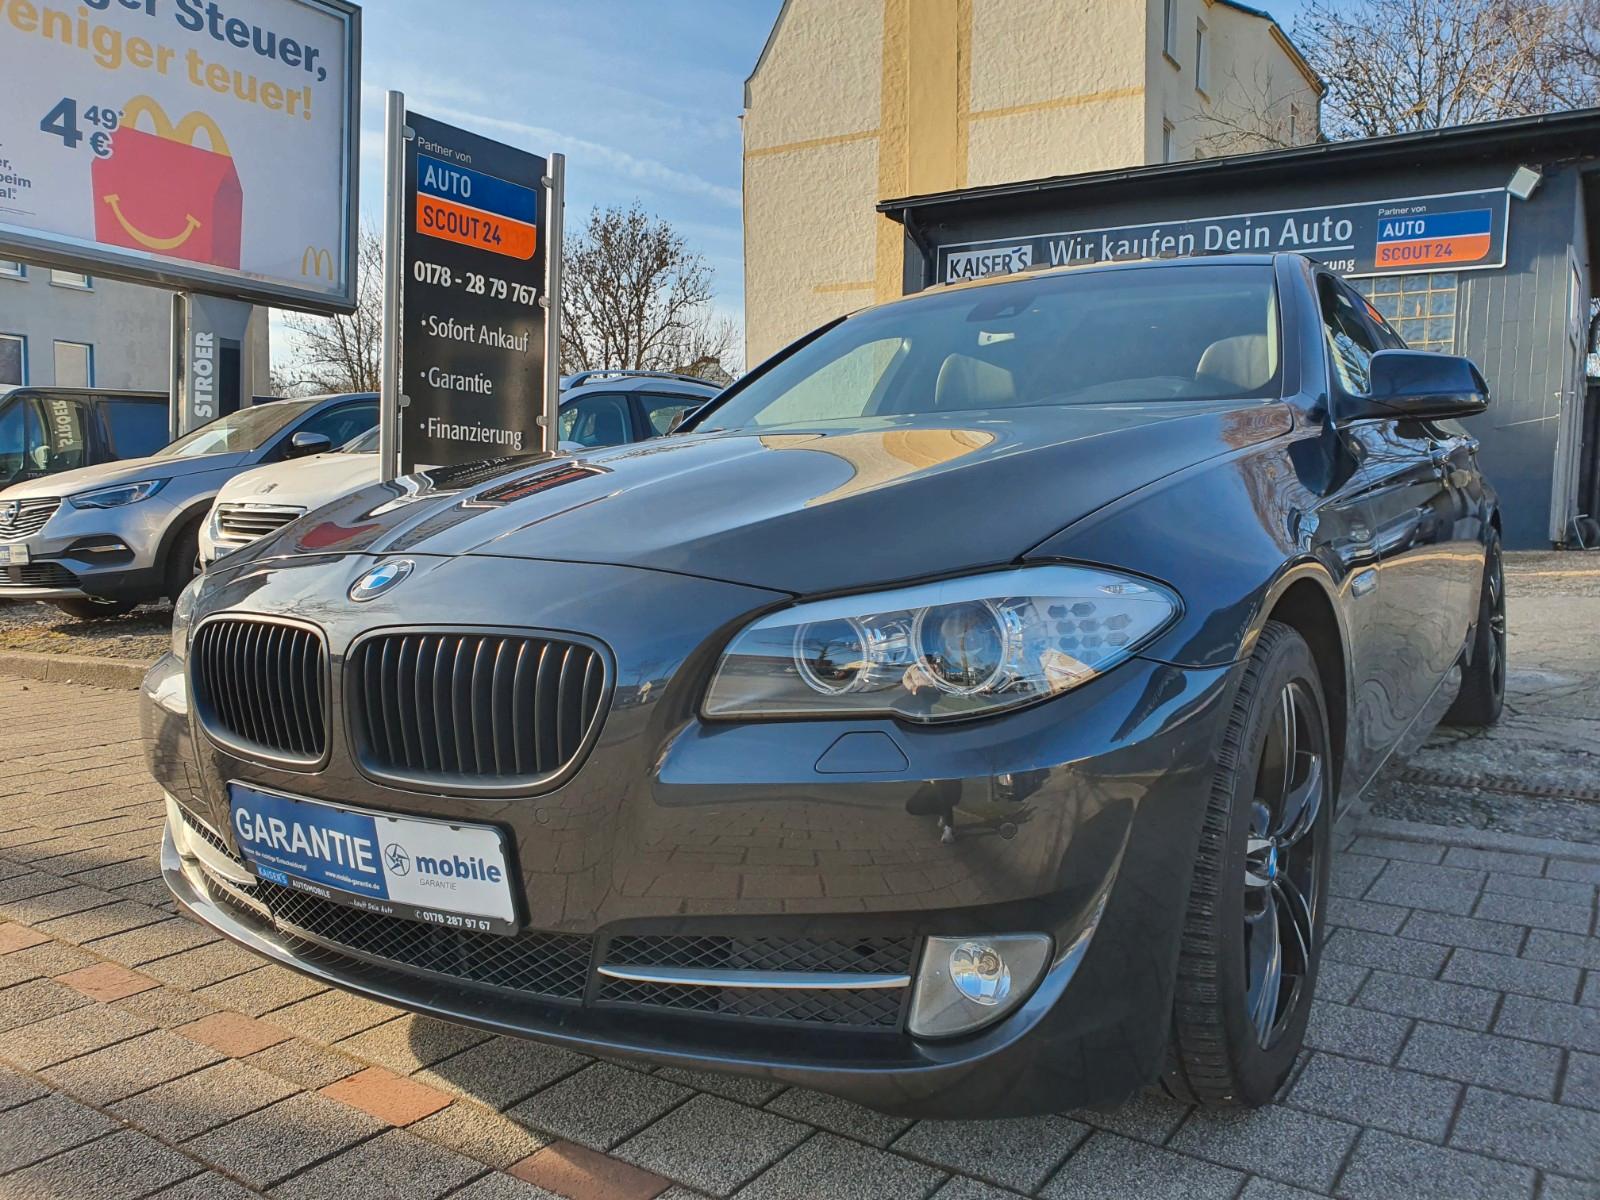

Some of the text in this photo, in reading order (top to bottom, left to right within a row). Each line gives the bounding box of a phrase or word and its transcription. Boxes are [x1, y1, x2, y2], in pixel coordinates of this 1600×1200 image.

[175, 0, 327, 82] Steuer,
[0, 0, 312, 120] eniger teuer!
[417, 136, 472, 164] Partner von
[424, 164, 472, 198] AUTO
[1378, 205, 1427, 217] Partner von
[1049, 215, 1353, 265] Wir kaufen Dein Auto
[1382, 220, 1425, 238] AUTO
[413, 260, 452, 288] 0178
[465, 272, 485, 295] 28
[488, 277, 508, 300] 79
[511, 283, 537, 306] 767
[428, 315, 529, 353] Sofort Ankauf
[194, 331, 214, 418] STRÖER
[428, 366, 493, 395] Garantie
[427, 417, 523, 451] Finanzierung
[235, 807, 377, 874] GARANTIE
[415, 855, 502, 883] mobile
[419, 879, 457, 891] GARANTIE
[423, 911, 491, 931] 0178 287 97 67
